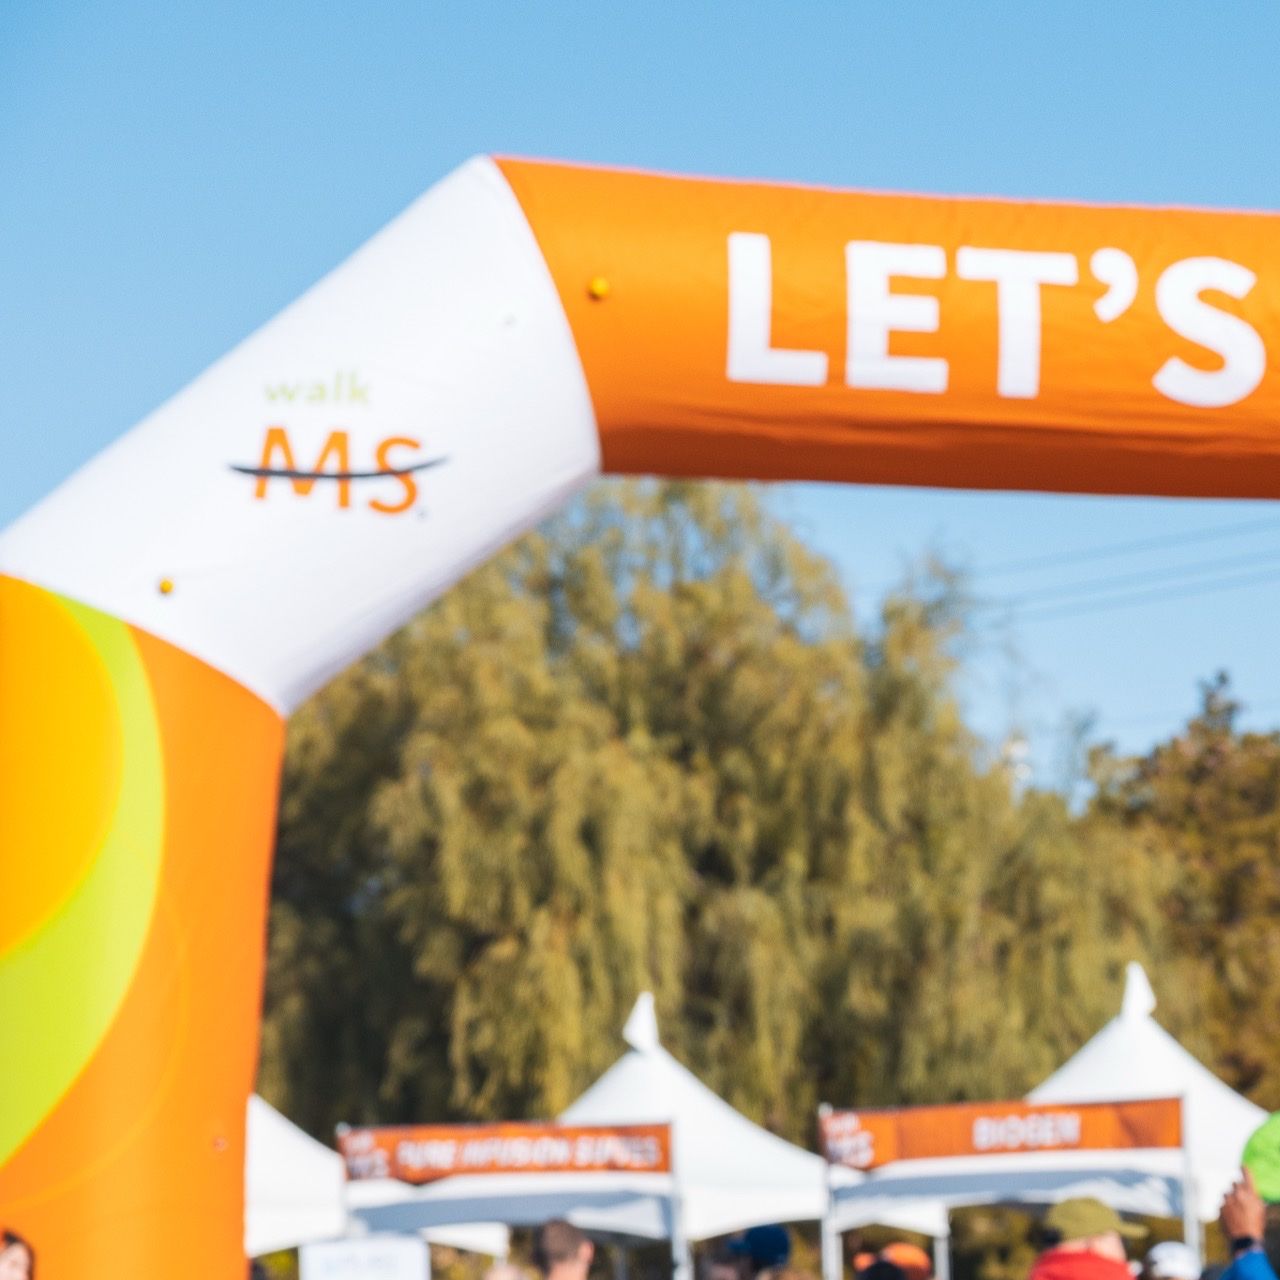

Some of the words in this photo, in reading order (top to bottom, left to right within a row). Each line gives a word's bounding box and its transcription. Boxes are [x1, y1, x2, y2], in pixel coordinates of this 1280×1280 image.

[726, 230, 1268, 408] LET’S
[264, 370, 371, 405] walk
[254, 424, 421, 516] MS
